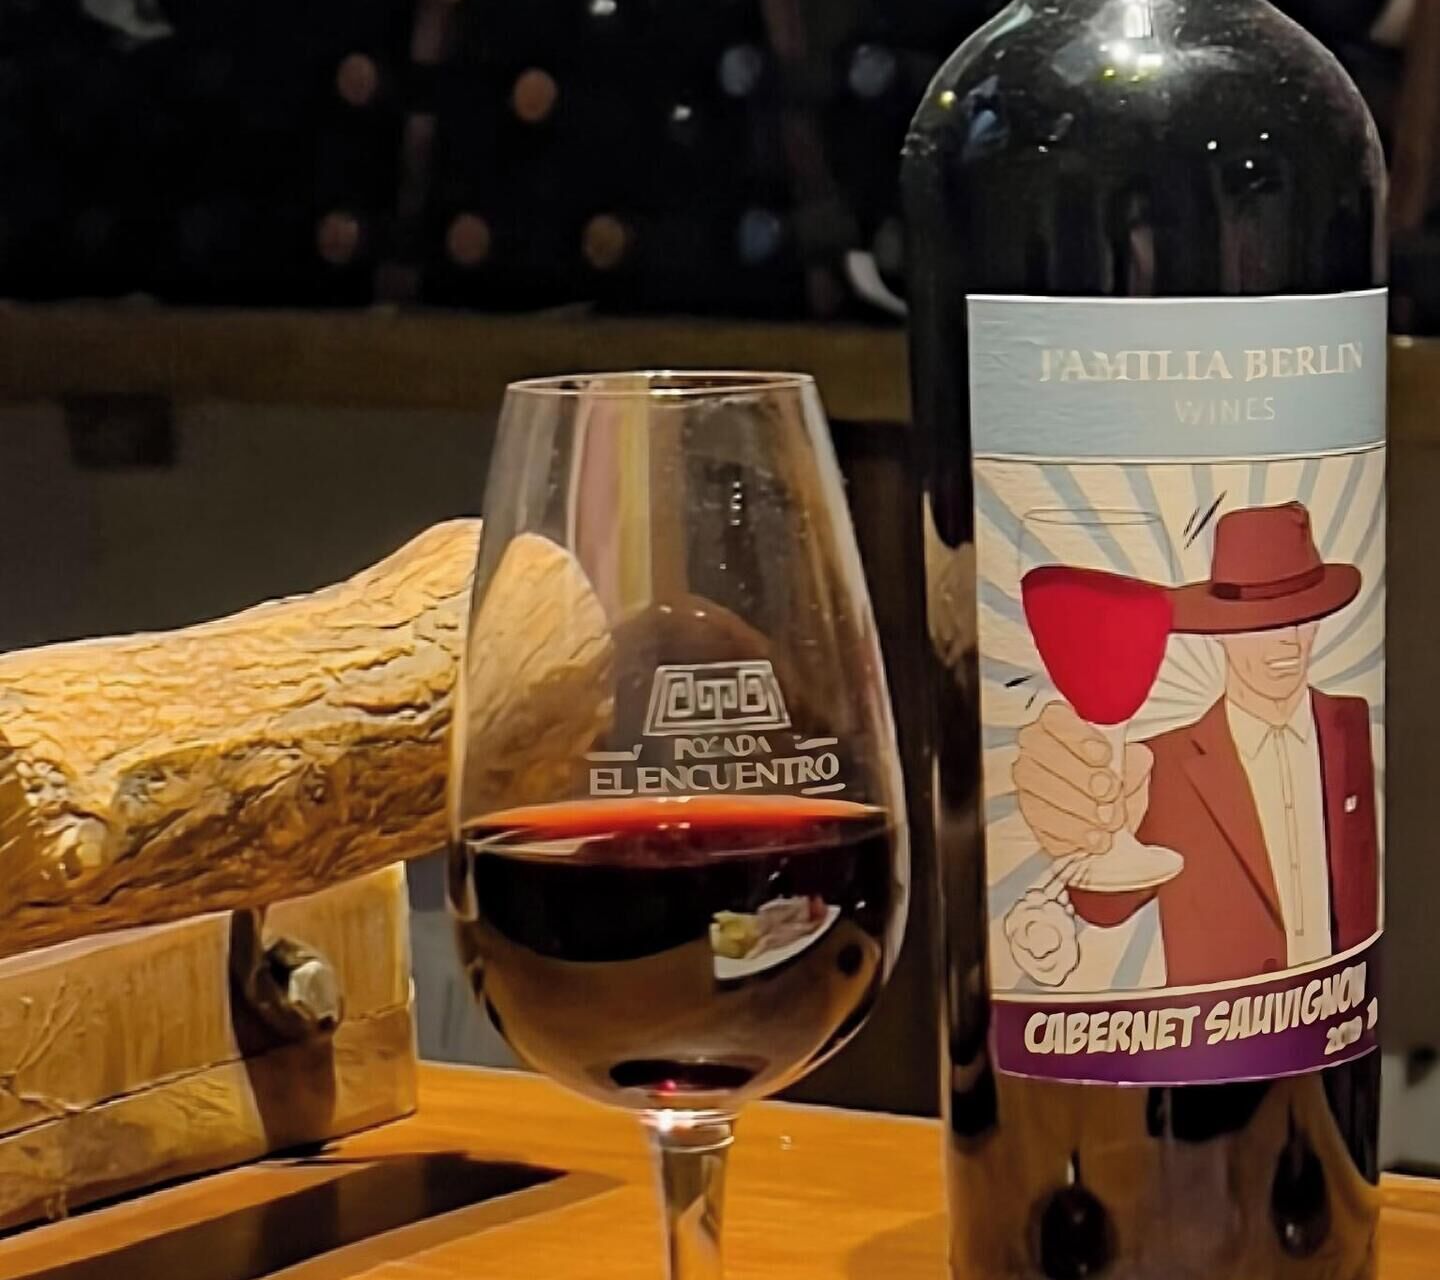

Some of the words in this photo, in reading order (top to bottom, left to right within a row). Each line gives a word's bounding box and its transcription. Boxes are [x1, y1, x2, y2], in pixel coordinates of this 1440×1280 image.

[1039, 349, 1233, 382] FAMILIA
[1244, 341, 1364, 383] BERLIN
[1173, 396, 1276, 426] WINES
[636, 752, 841, 794] ENCUENTRO
[1024, 1005, 1201, 1056] CABERNET
[1206, 960, 1367, 1046] SAUVIGNON
